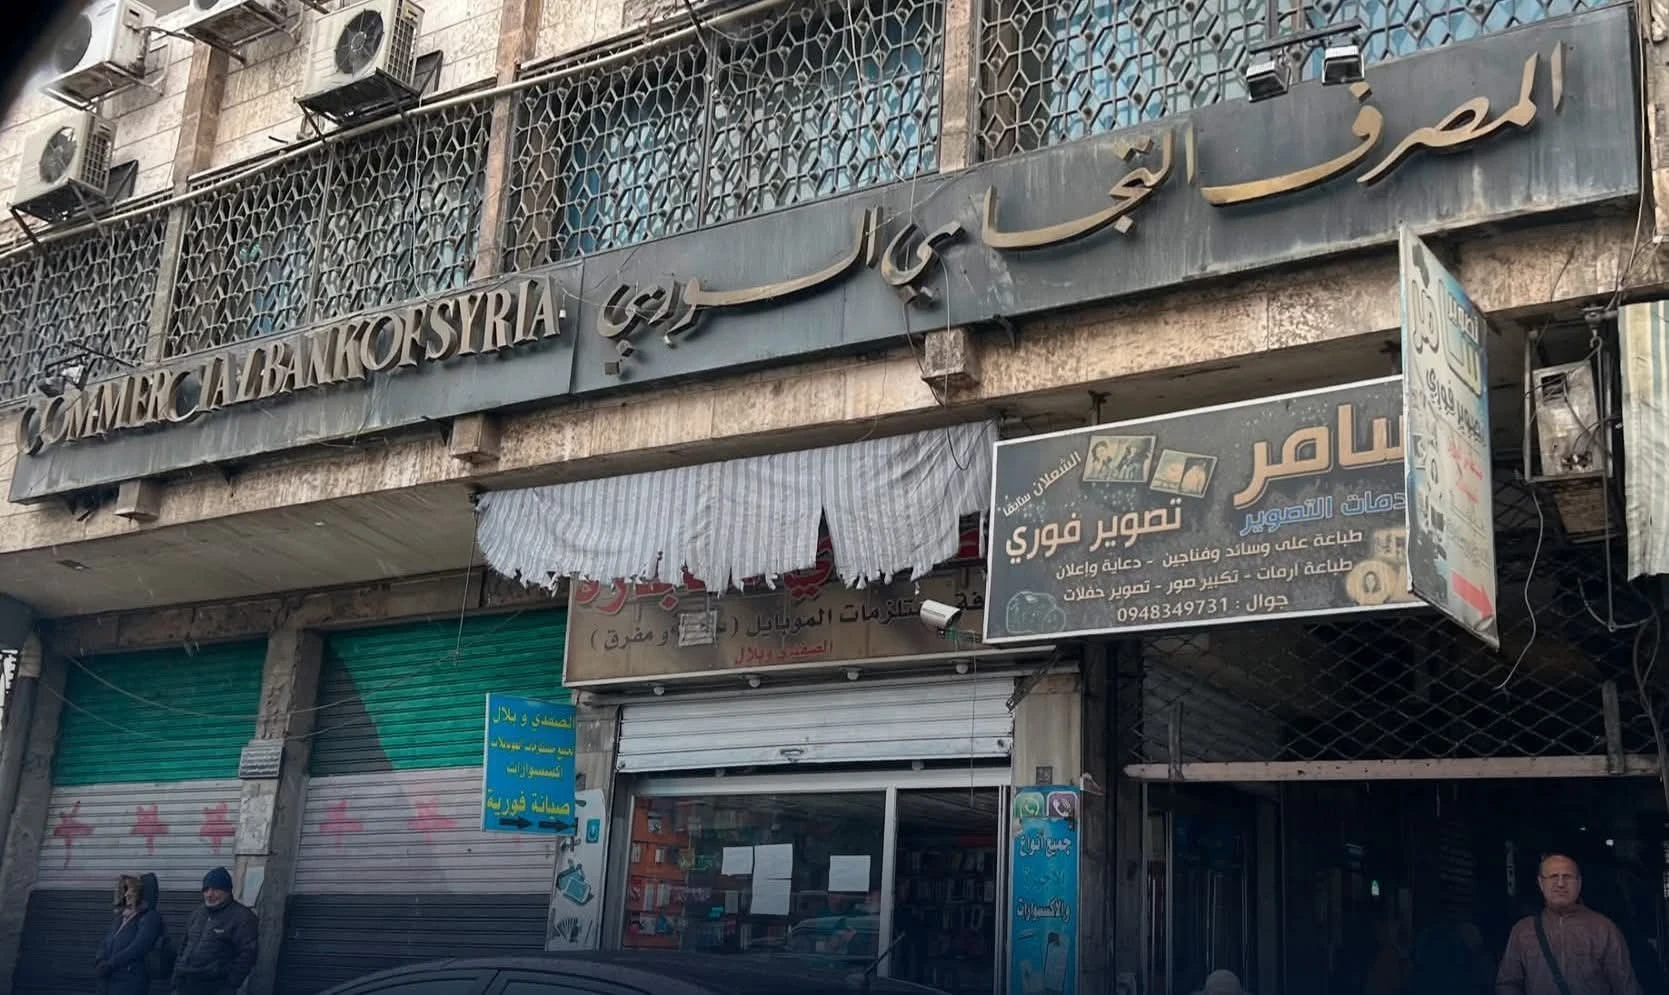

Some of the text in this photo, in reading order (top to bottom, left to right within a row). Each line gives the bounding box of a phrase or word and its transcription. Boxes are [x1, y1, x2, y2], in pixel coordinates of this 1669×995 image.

[597, 40, 1565, 375] المصرف التجاي السوري
[1033, 451, 1081, 496] الشعلان
[1240, 491, 1407, 536] دمات التصوير
[1089, 498, 1182, 552] تصوير
[1005, 513, 1081, 564] فوري
[1275, 538, 1308, 551] على
[1313, 530, 1363, 549] طباعة
[1162, 548, 1220, 568] وفناجين
[1226, 541, 1270, 557] وسائد
[1102, 557, 1142, 573] دعاية
[1304, 558, 1353, 575] طباعة
[1166, 575, 1196, 595] صور
[1199, 569, 1239, 590] تكبير
[1063, 586, 1105, 602] حفلات
[1109, 580, 1150, 600] تصوير
[1117, 597, 1228, 622] 0948349731
[1245, 594, 1289, 612] جوال
[487, 789, 570, 819] صيانة فورية
[1046, 835, 1072, 857] جميع
